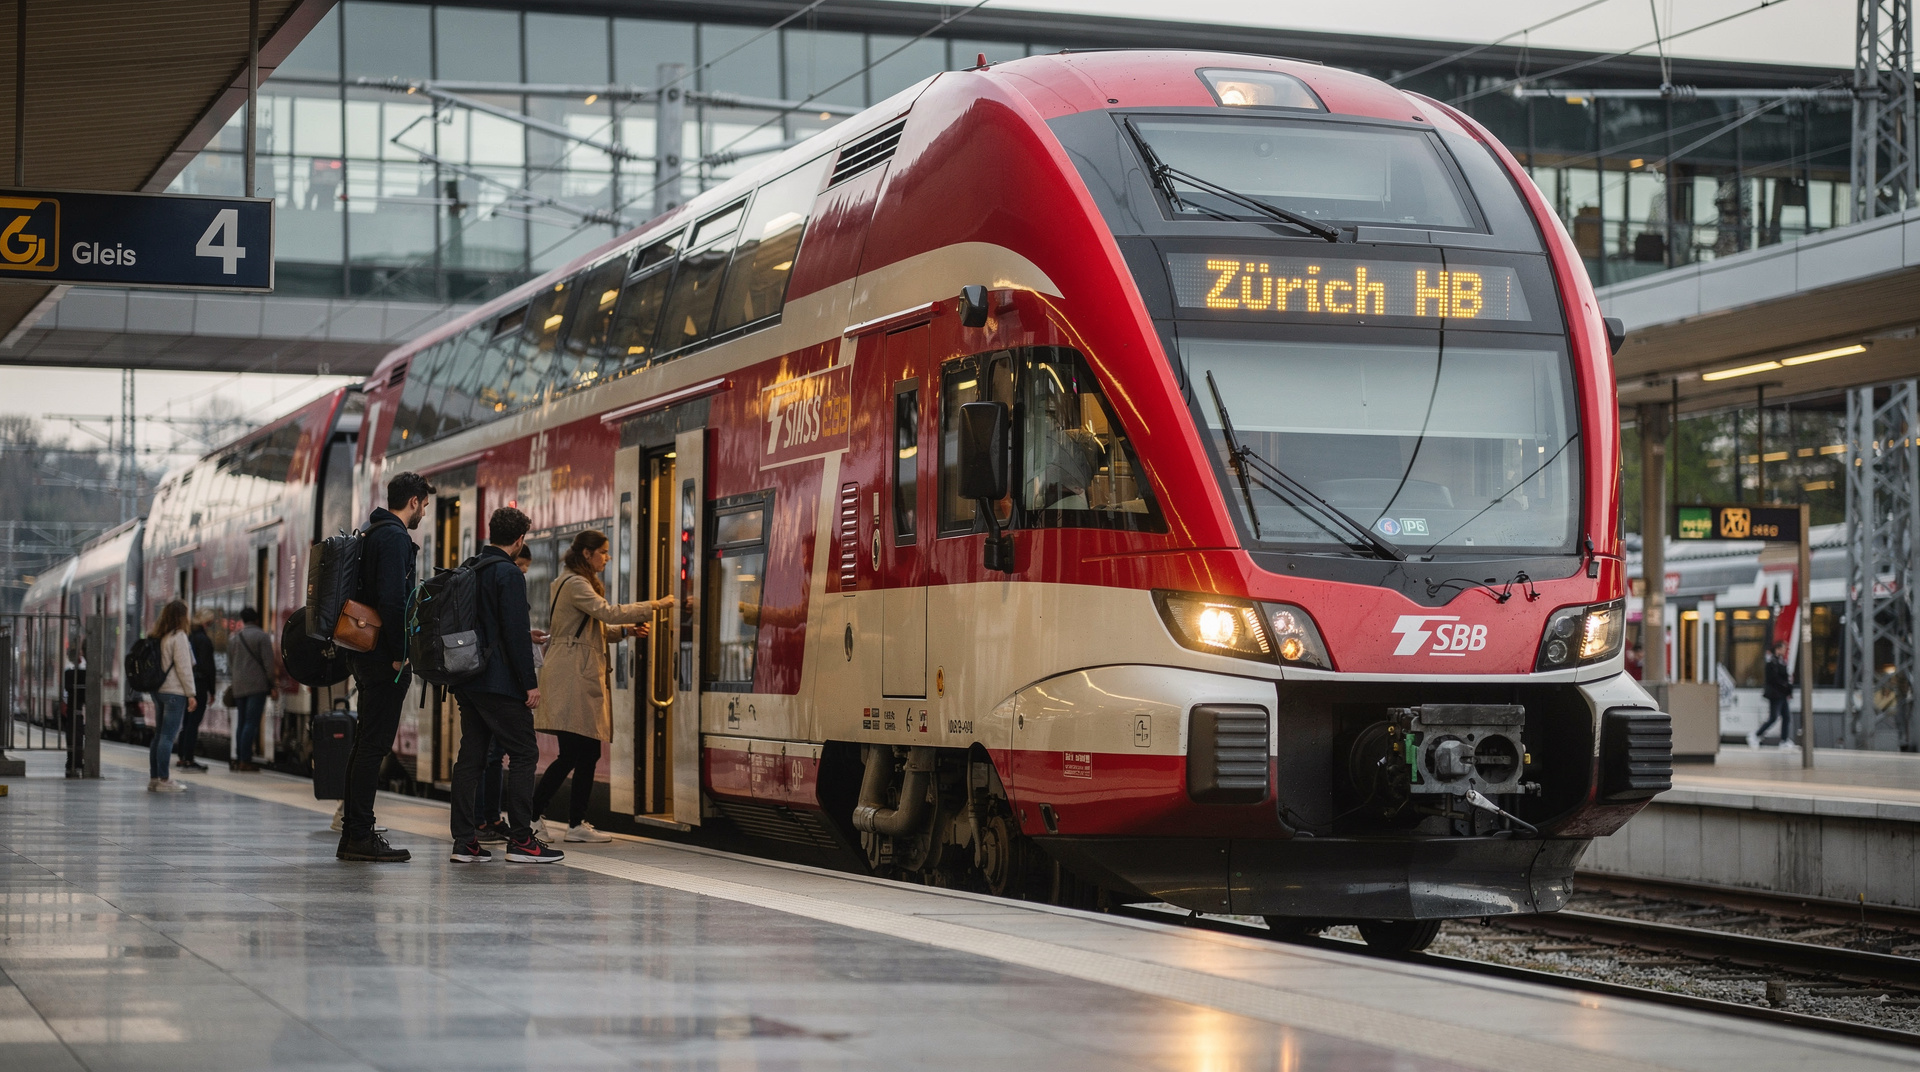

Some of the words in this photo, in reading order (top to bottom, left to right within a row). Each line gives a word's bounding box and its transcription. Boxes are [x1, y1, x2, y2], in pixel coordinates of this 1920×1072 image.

[72, 241, 137, 266] Gleis
[195, 208, 246, 275] 4
[1206, 259, 1386, 315] Zürich
[1415, 269, 1483, 318] HB
[1432, 623, 1488, 651] SBB
